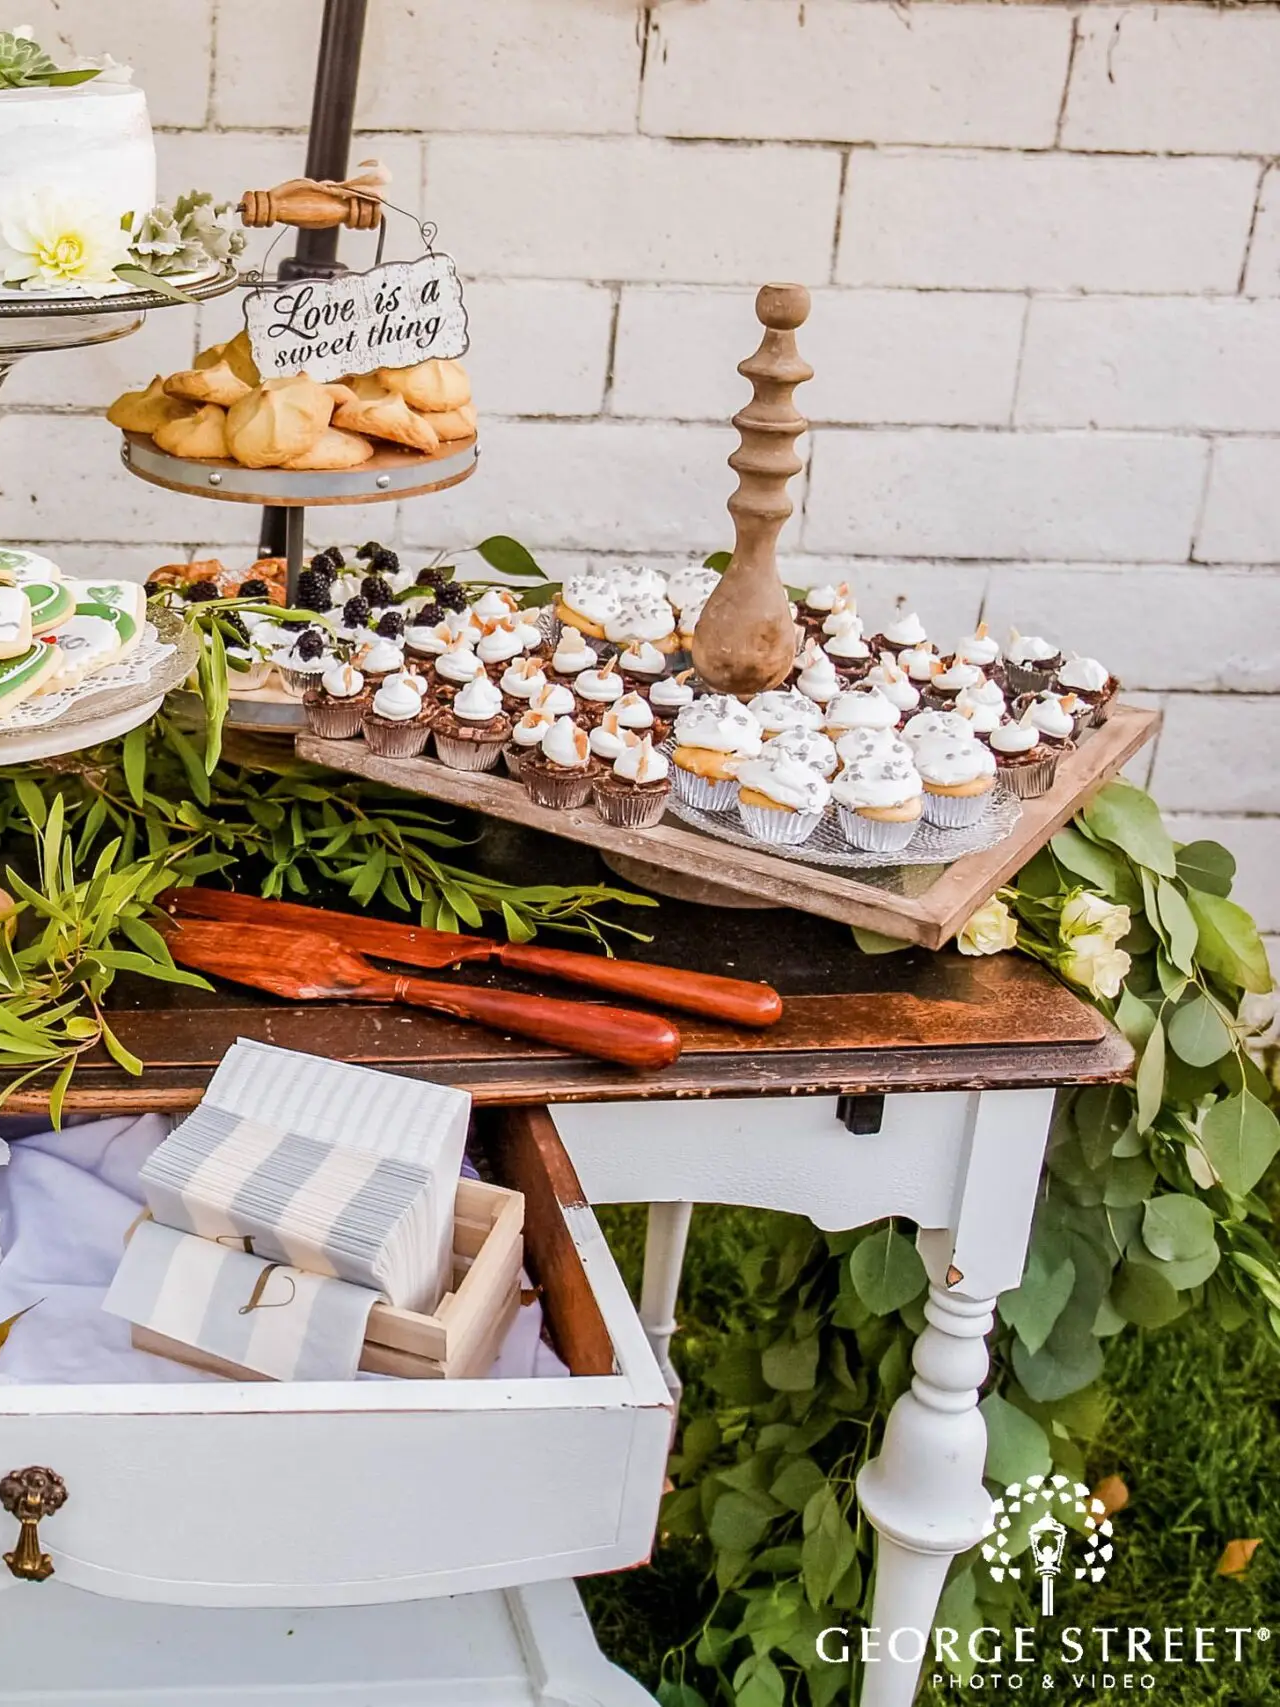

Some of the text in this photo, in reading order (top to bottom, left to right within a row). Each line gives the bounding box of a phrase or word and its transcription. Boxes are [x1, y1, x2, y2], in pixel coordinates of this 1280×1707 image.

[267, 278, 440, 340] Love is a
[274, 314, 447, 367] sweet thing
